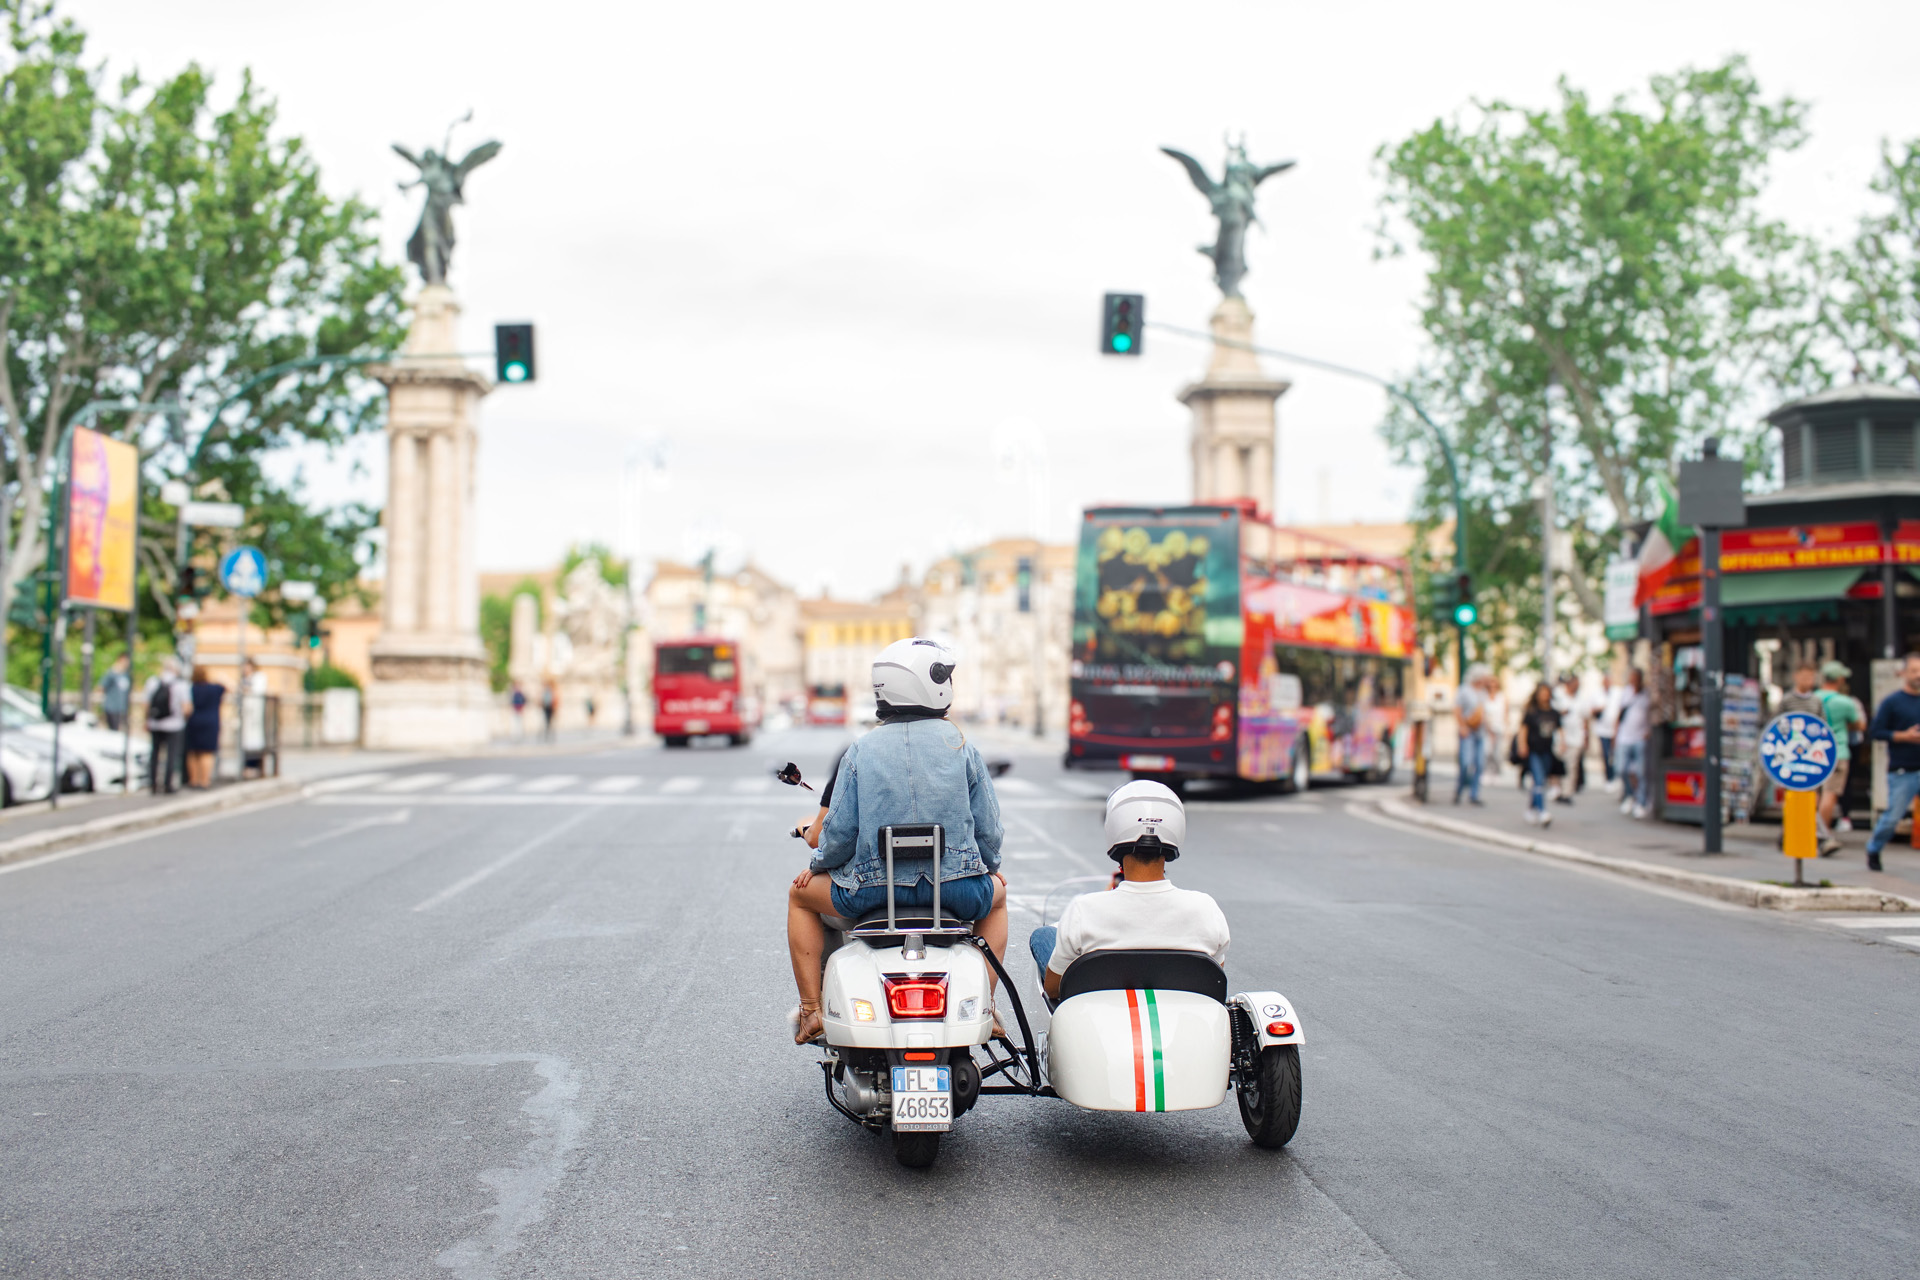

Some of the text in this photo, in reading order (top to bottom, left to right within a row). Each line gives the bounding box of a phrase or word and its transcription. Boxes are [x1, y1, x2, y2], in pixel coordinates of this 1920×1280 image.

[1719, 551, 1790, 571] OFFICIAL
[1794, 545, 1878, 566] RETAILER
[906, 1069, 928, 1091] FL
[896, 1097, 949, 1119] 46853
